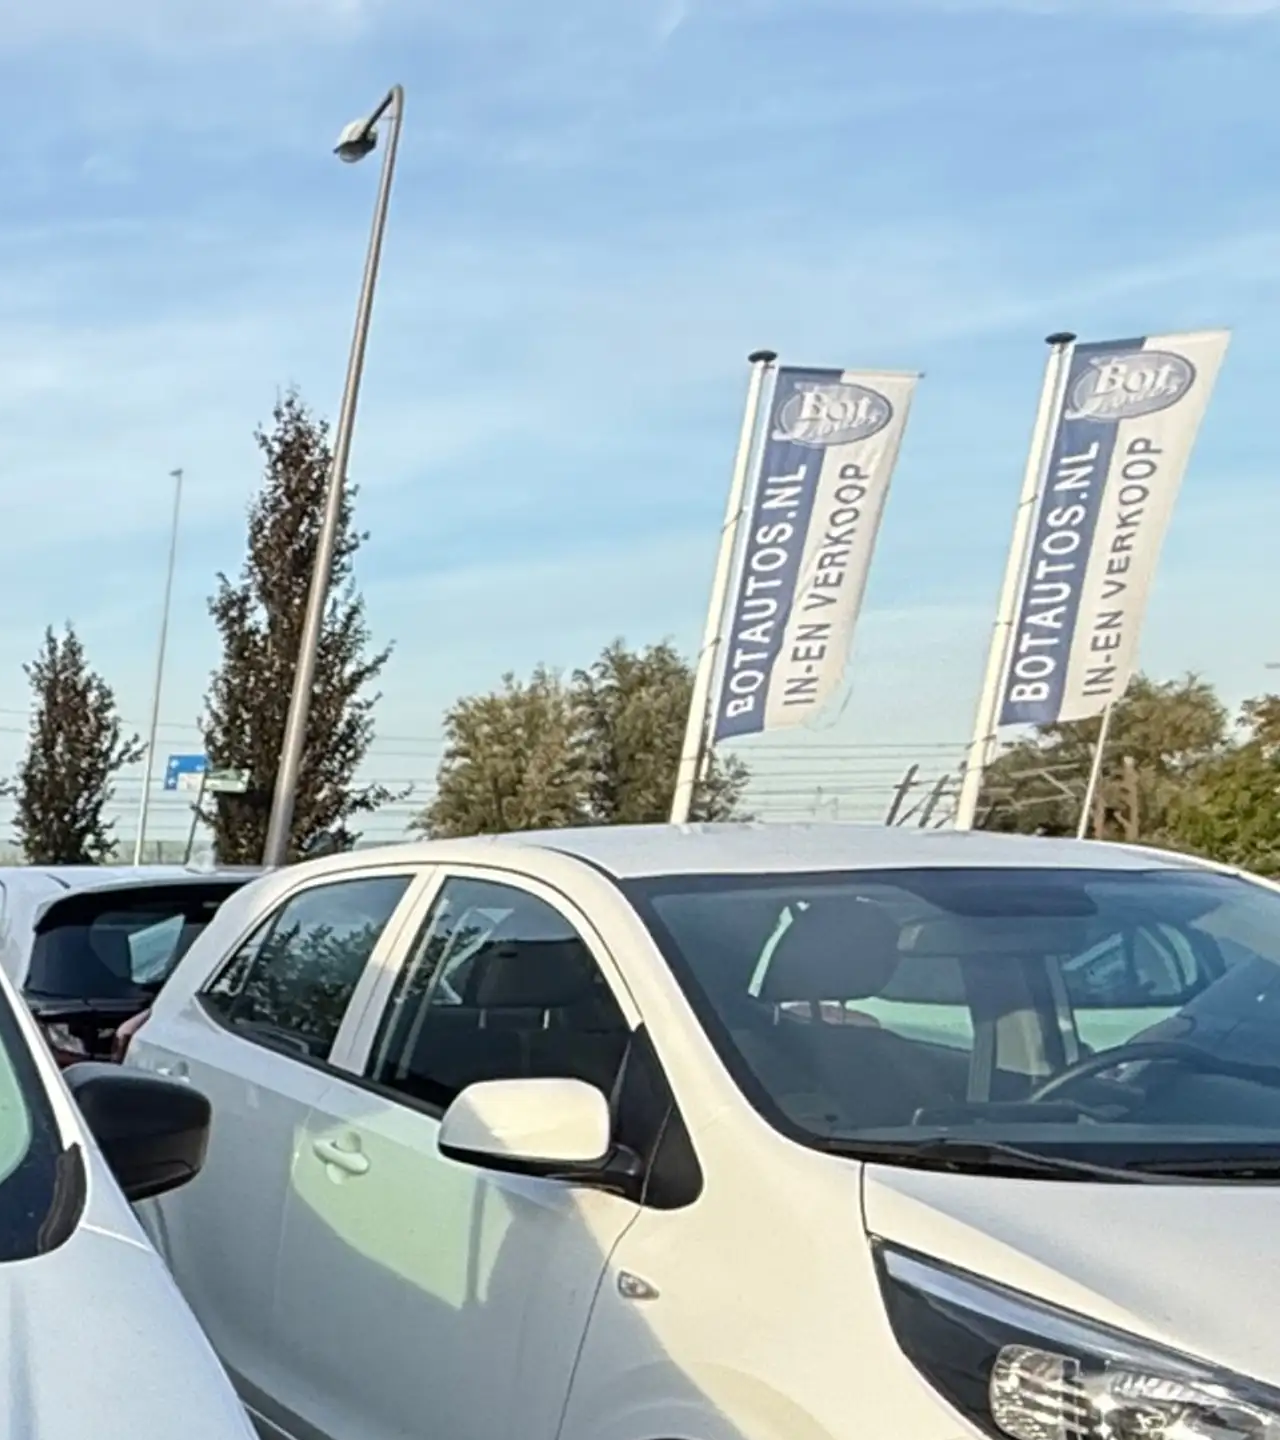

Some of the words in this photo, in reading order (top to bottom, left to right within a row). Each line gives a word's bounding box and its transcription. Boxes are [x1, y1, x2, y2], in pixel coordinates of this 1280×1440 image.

[799, 391, 871, 424] Bot
[1095, 362, 1176, 395] Bot
[803, 463, 869, 612] VERKOOP
[1010, 442, 1100, 702] BOTAUTOS.NL
[1101, 437, 1162, 599] VERKOOP
[726, 464, 807, 717] BOTAUTOS.NL
[783, 623, 831, 706] IN-EN
[1083, 610, 1123, 697] IN-EN
